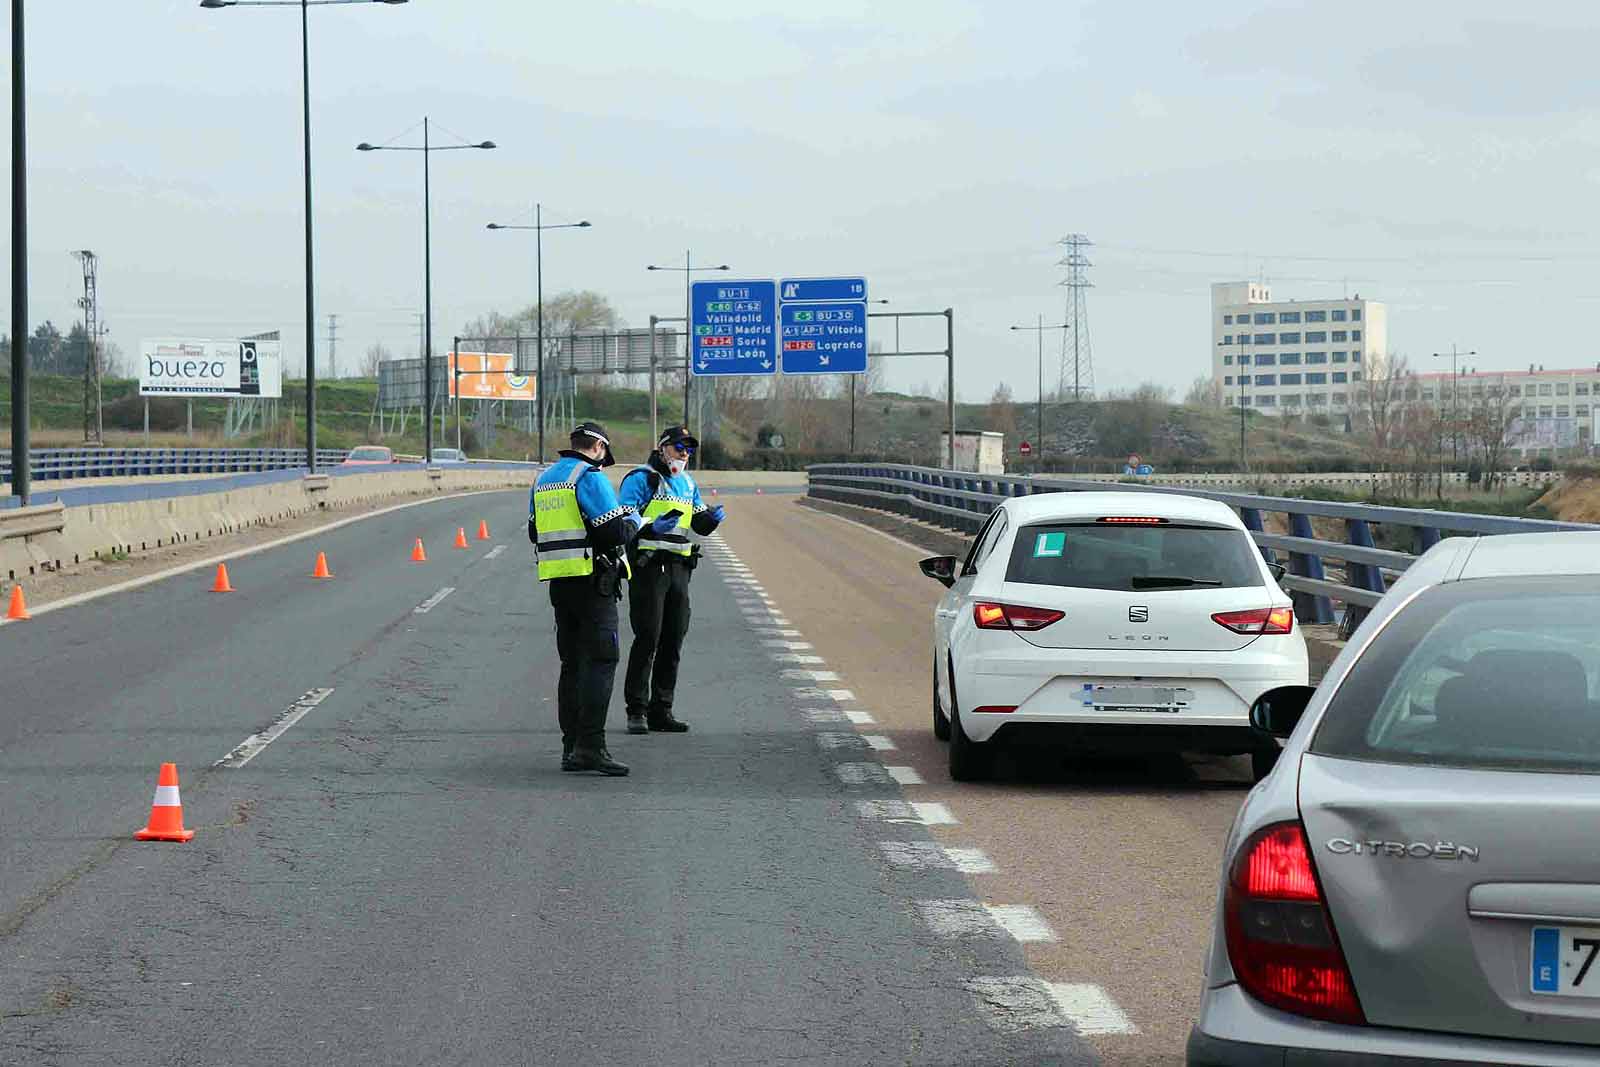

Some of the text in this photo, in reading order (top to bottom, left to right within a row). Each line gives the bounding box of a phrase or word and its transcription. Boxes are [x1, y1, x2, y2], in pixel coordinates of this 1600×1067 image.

[719, 290, 750, 298] BU-11
[736, 302, 760, 310] A-62
[706, 314, 762, 323] Valladolid
[817, 311, 852, 320] BU-30
[735, 326, 771, 334] Madrid
[827, 325, 864, 334] Vitoria
[736, 337, 767, 346] Soria
[784, 341, 863, 352] N-120 Logroño
[703, 349, 766, 358] A-231 León
[145, 353, 225, 377] buezo
[1036, 533, 1061, 556] L
[1326, 838, 1480, 862] CITROËN
[1540, 966, 1552, 981] E
